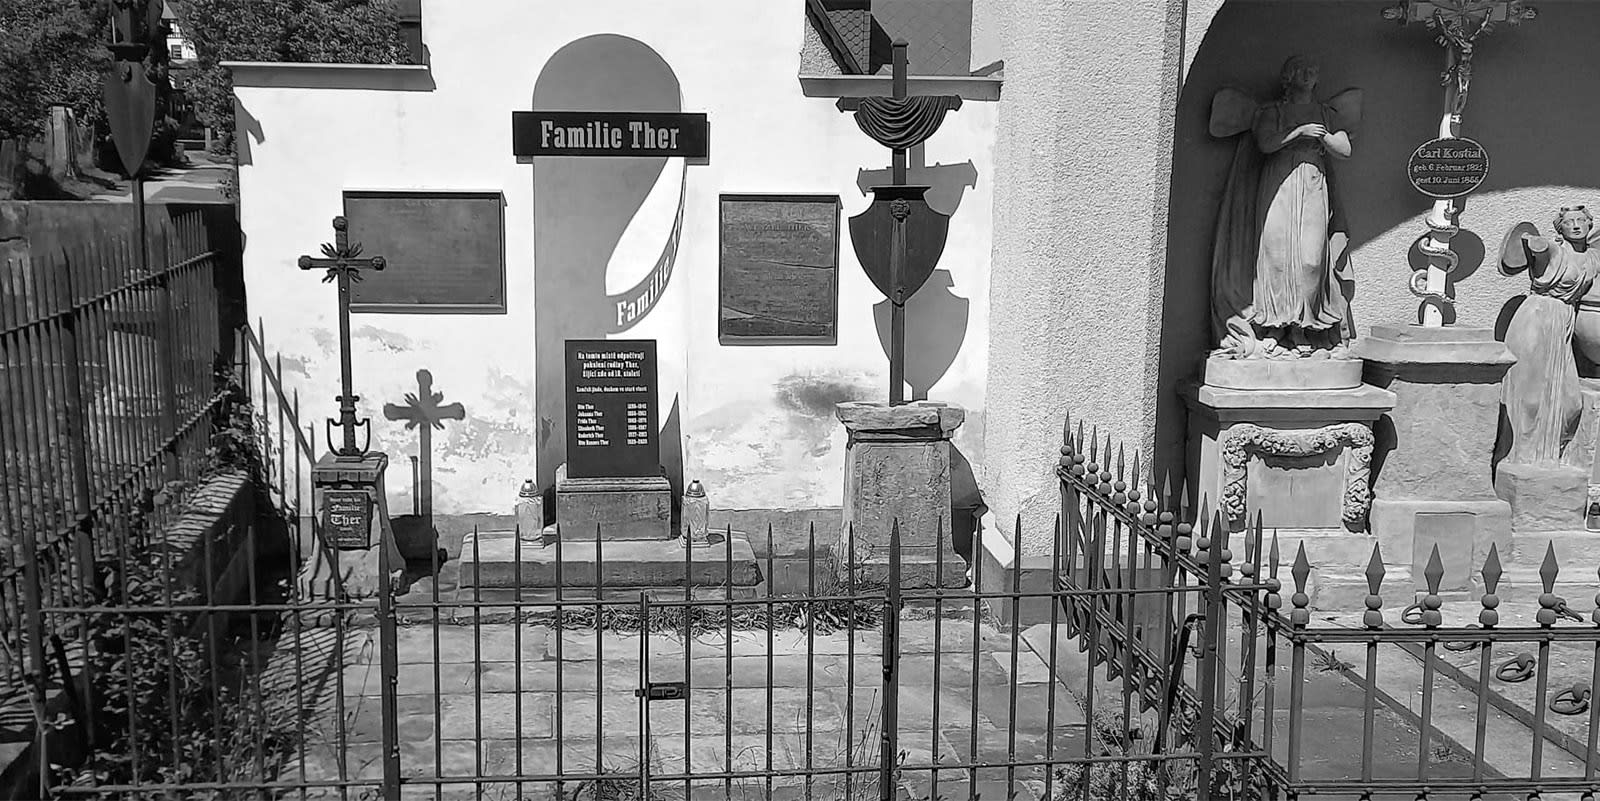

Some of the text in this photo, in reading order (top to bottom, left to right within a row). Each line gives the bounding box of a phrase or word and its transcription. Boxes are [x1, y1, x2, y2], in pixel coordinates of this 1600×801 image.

[628, 121, 680, 150] Ther
[1418, 147, 1482, 159] Carl Kostial
[1435, 163, 1466, 172] Februar
[1443, 176, 1460, 184] Juni
[330, 514, 362, 526] Ther
